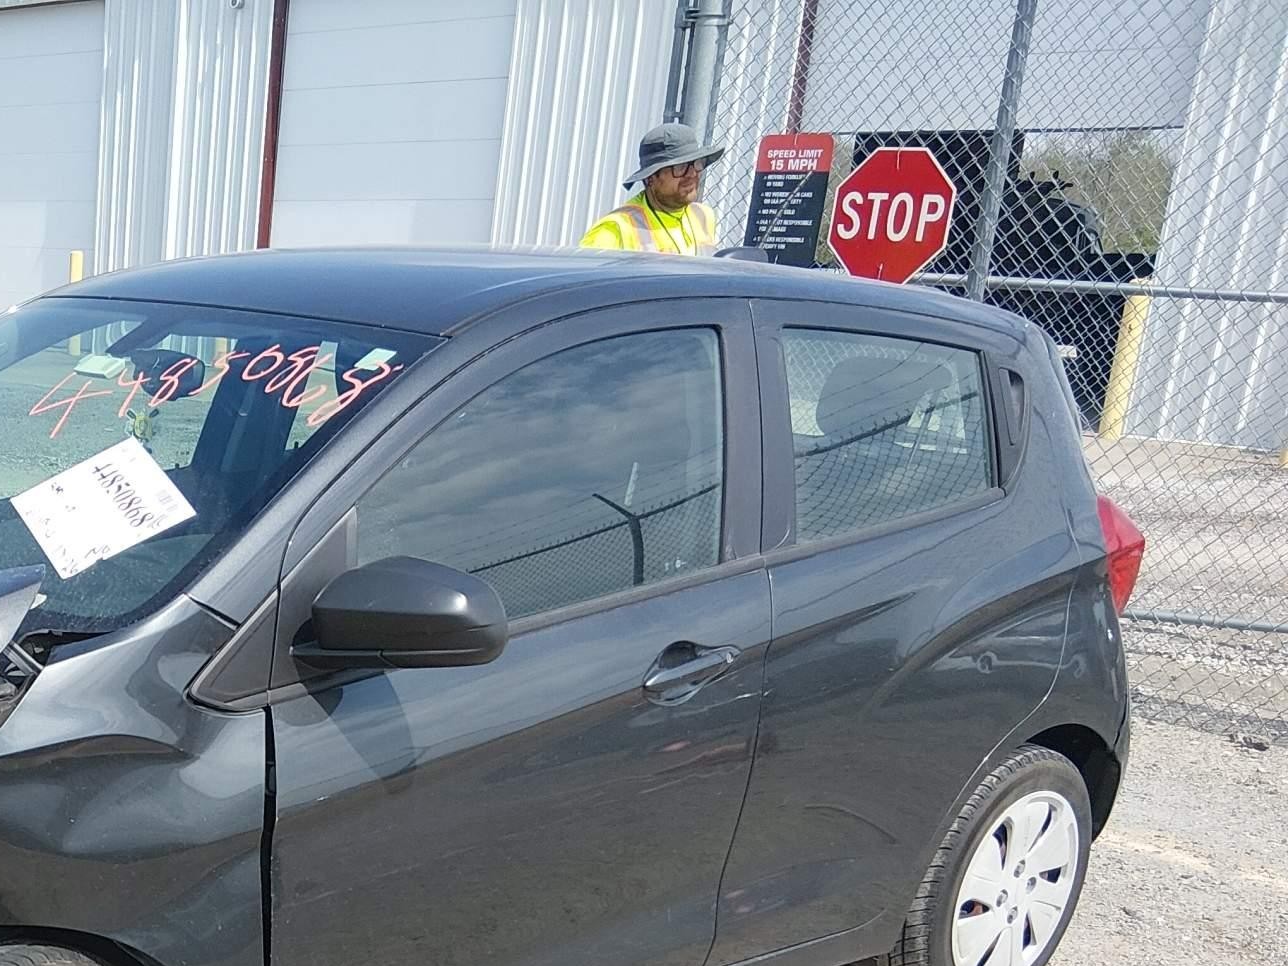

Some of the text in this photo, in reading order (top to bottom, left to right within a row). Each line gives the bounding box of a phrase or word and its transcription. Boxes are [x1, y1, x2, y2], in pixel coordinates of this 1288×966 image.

[767, 149, 824, 159] SPEED LIMIT
[770, 159, 818, 171] 15 MPH
[836, 191, 946, 242] STOP
[29, 344, 404, 440] 44850868
[92, 463, 154, 528] 44850868
